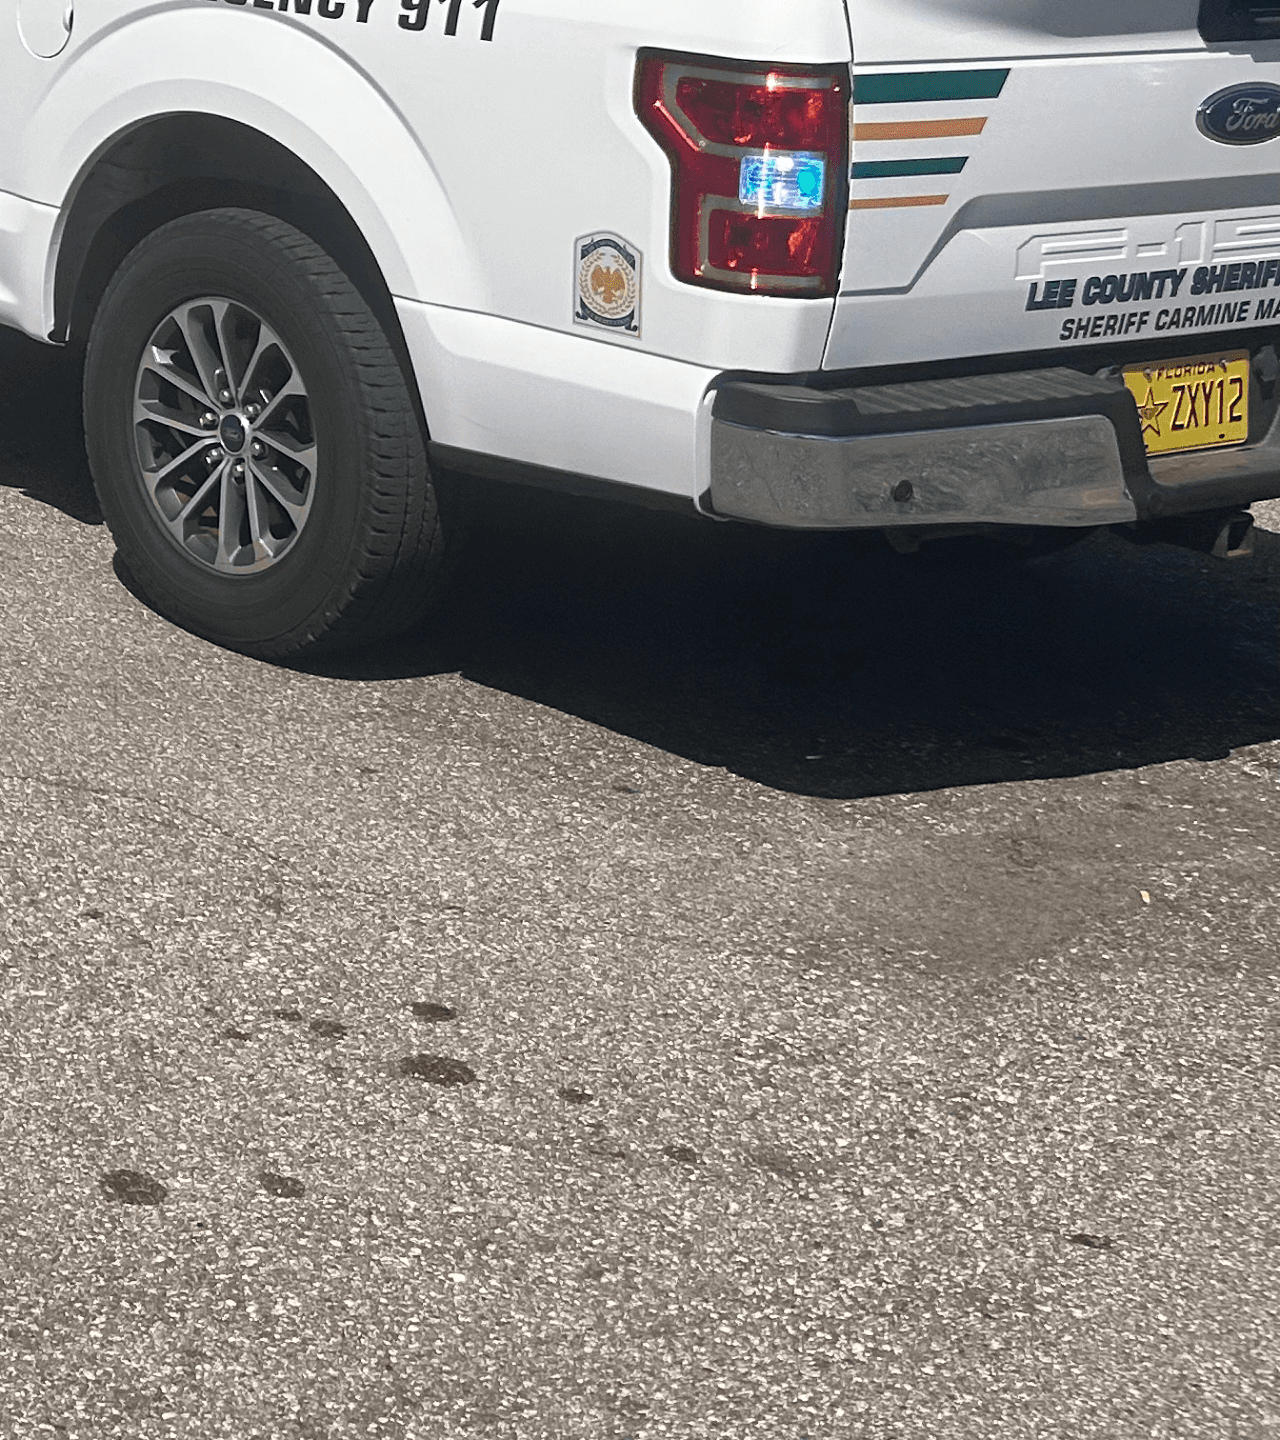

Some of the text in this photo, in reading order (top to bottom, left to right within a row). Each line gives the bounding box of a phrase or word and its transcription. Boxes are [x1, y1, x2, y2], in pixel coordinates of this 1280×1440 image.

[1225, 97, 1280, 132] Ford
[1025, 278, 1078, 312] LEE
[1081, 268, 1187, 306] COUNTY
[1059, 311, 1151, 341] SHERIFF
[1154, 300, 1252, 331] CARMINE
[1156, 361, 1216, 381] FLORIDA
[1169, 375, 1243, 432] ZXY12
